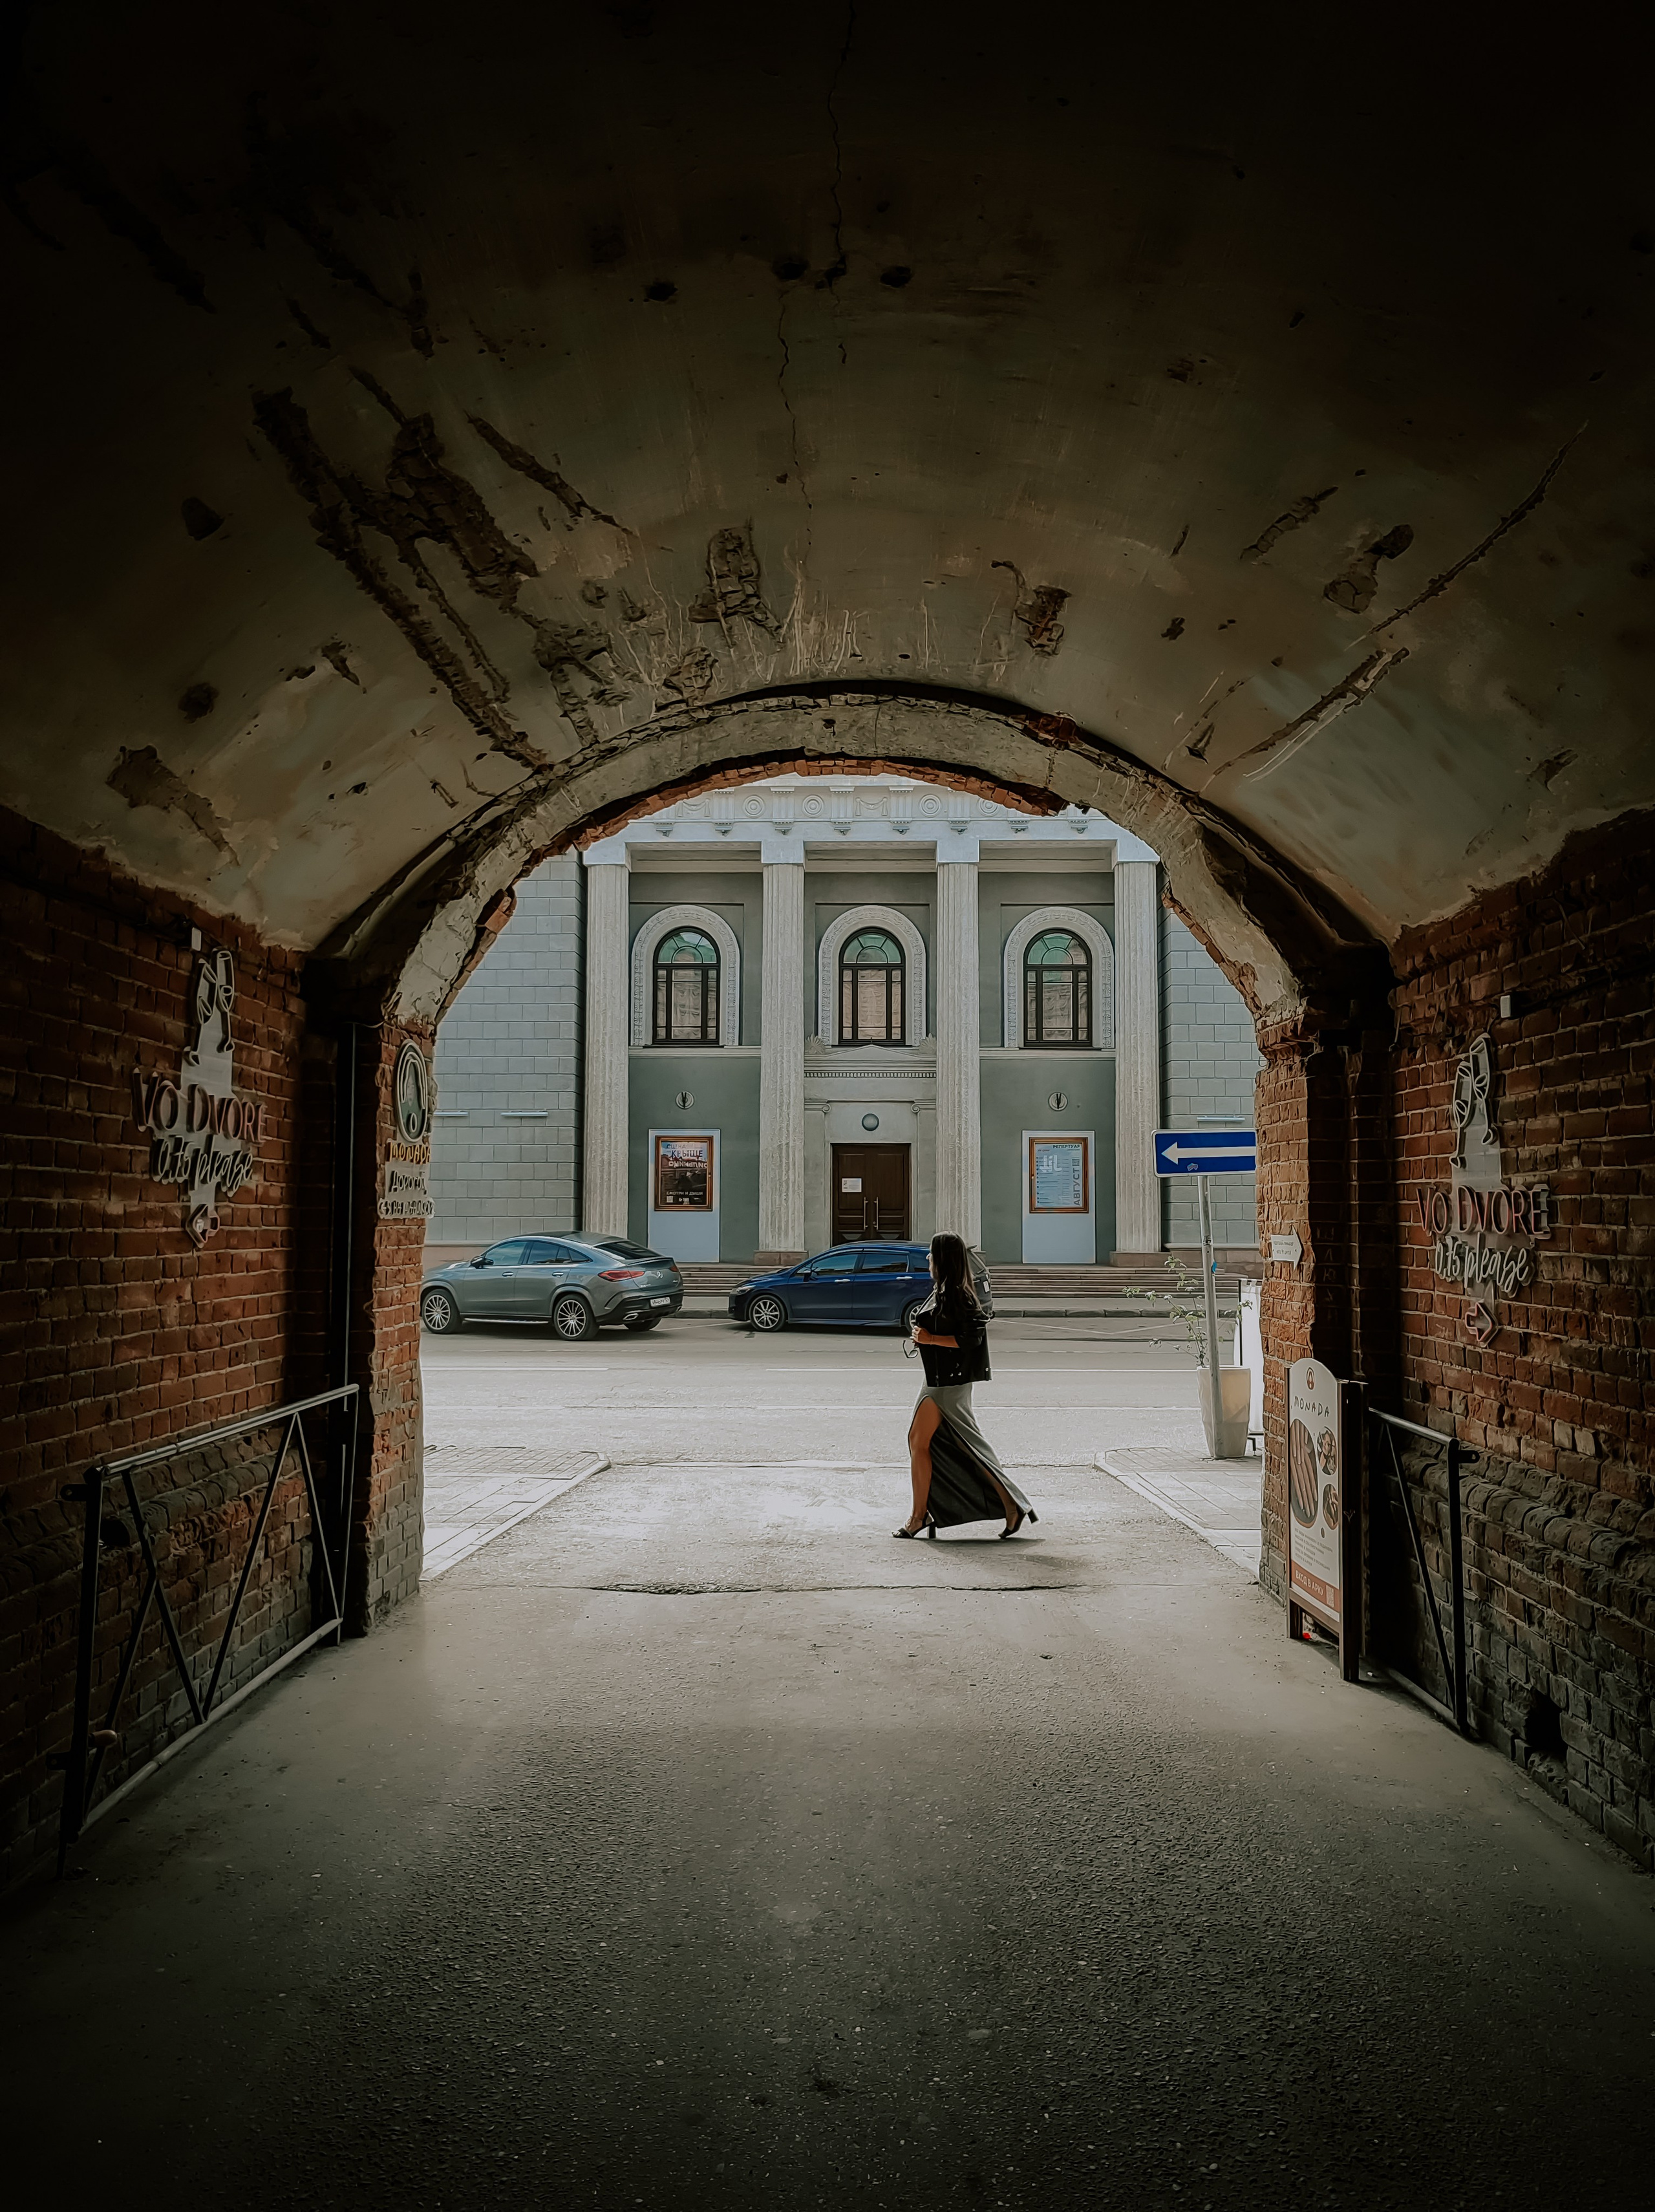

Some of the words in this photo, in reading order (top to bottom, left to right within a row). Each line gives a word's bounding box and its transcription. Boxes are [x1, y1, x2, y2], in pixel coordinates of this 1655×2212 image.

[132, 1068, 179, 1132] VO
[187, 1084, 268, 1143] DVORE
[190, 1135, 253, 1194] please
[387, 1142, 431, 1165] MONADA
[1416, 1187, 1449, 1235] VO
[1457, 1184, 1549, 1238] DVORE
[1435, 1236, 1463, 1282] 0,75
[1464, 1232, 1532, 1295] please
[1294, 1395, 1330, 1417] MONADA
[1296, 1570, 1307, 1586] ВХОД
[1307, 1578, 1311, 1588] В
[1312, 1582, 1324, 1596] АРКУ
